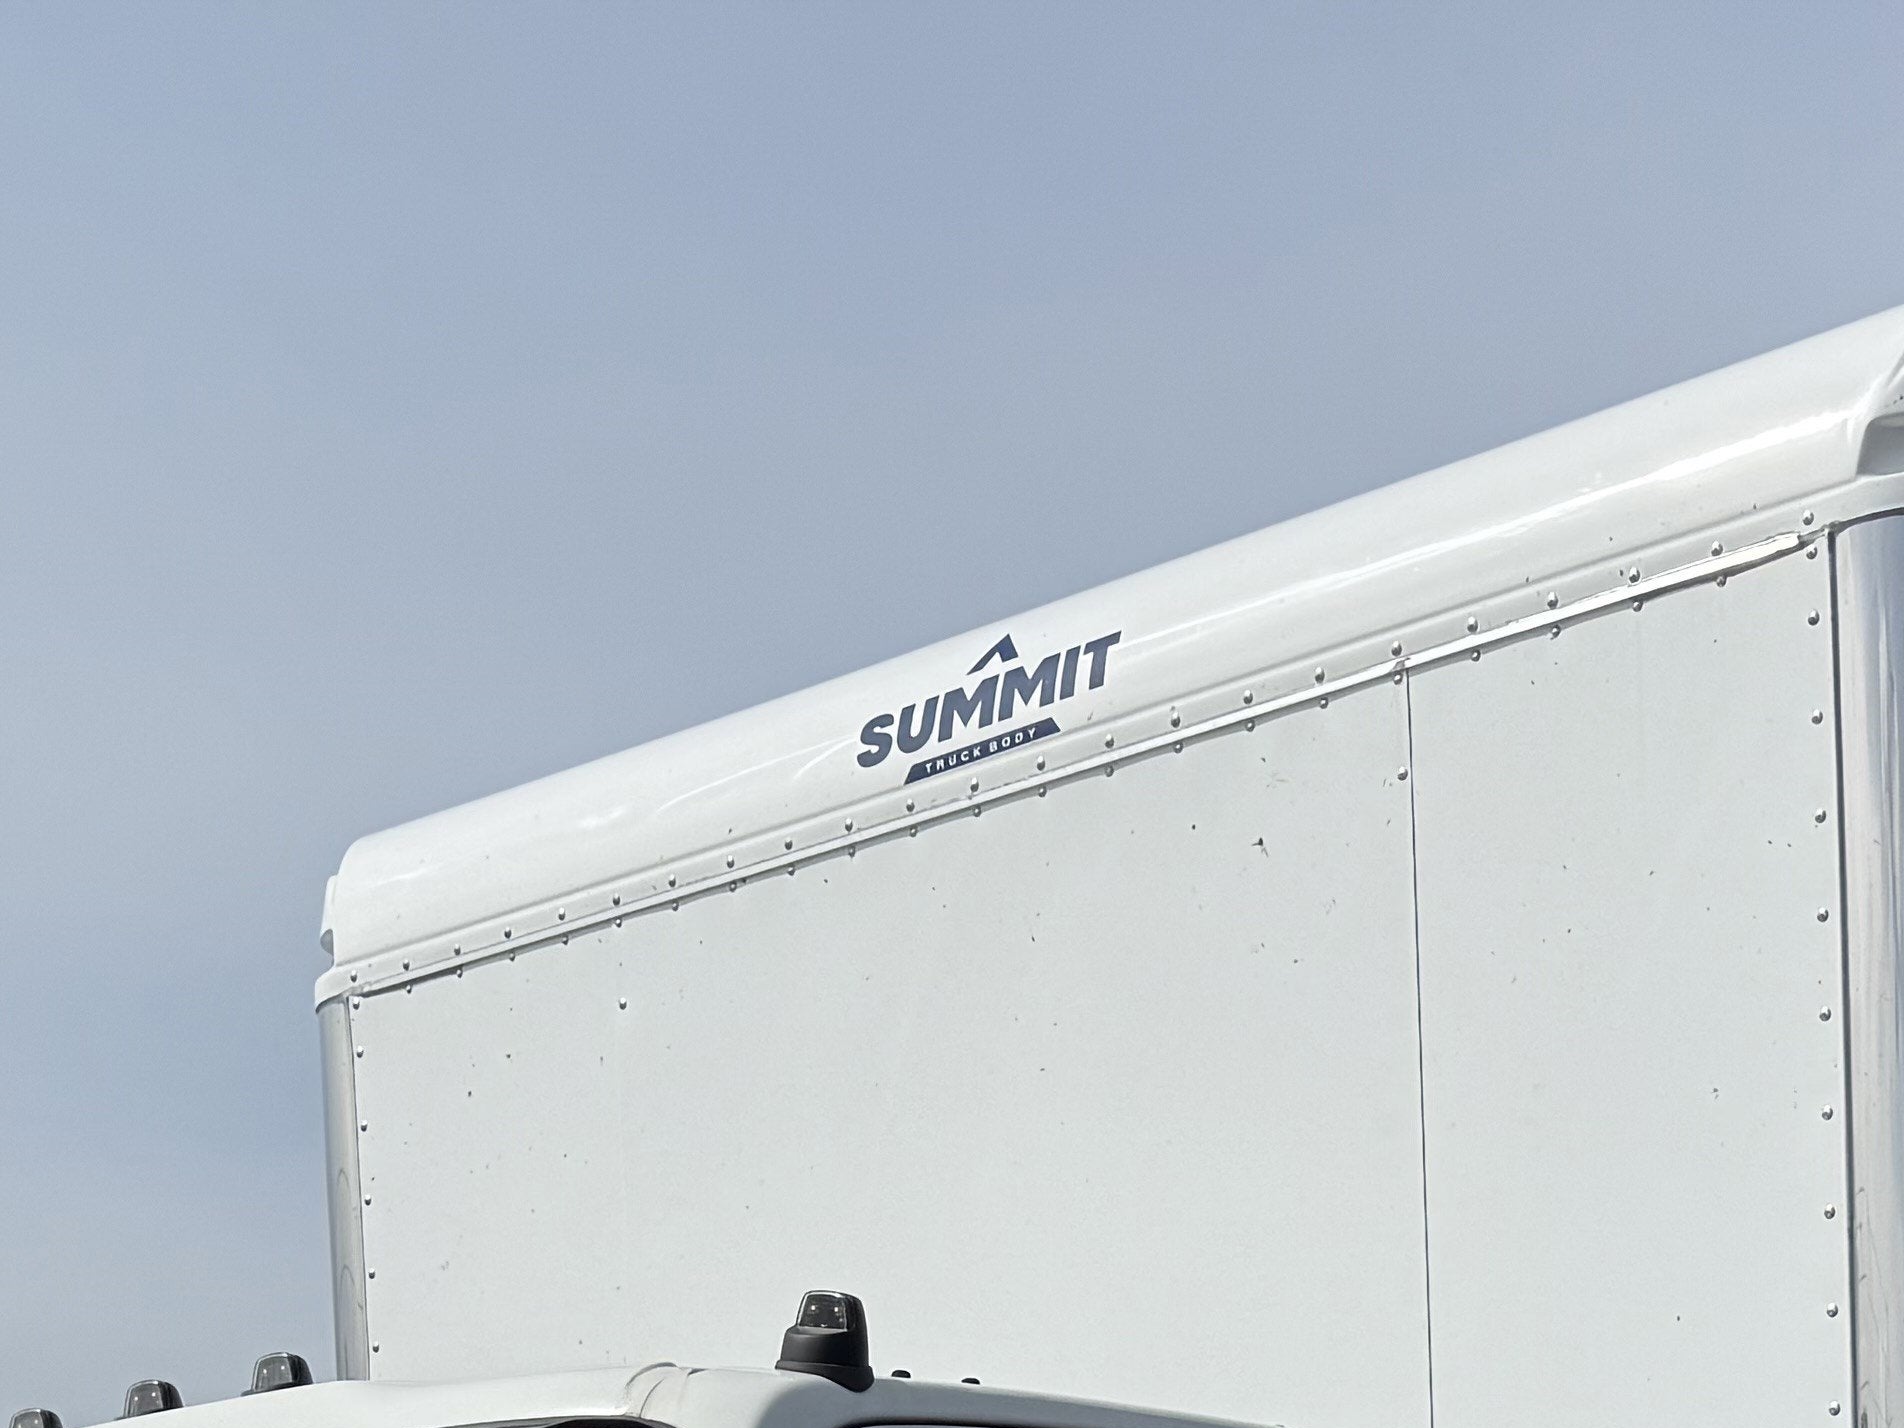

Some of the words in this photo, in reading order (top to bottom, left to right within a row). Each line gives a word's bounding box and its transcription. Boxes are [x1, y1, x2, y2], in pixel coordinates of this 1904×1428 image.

[856, 630, 1122, 768] SUMMIT
[925, 745, 983, 775] TRUCK
[989, 726, 1037, 753] BODY
